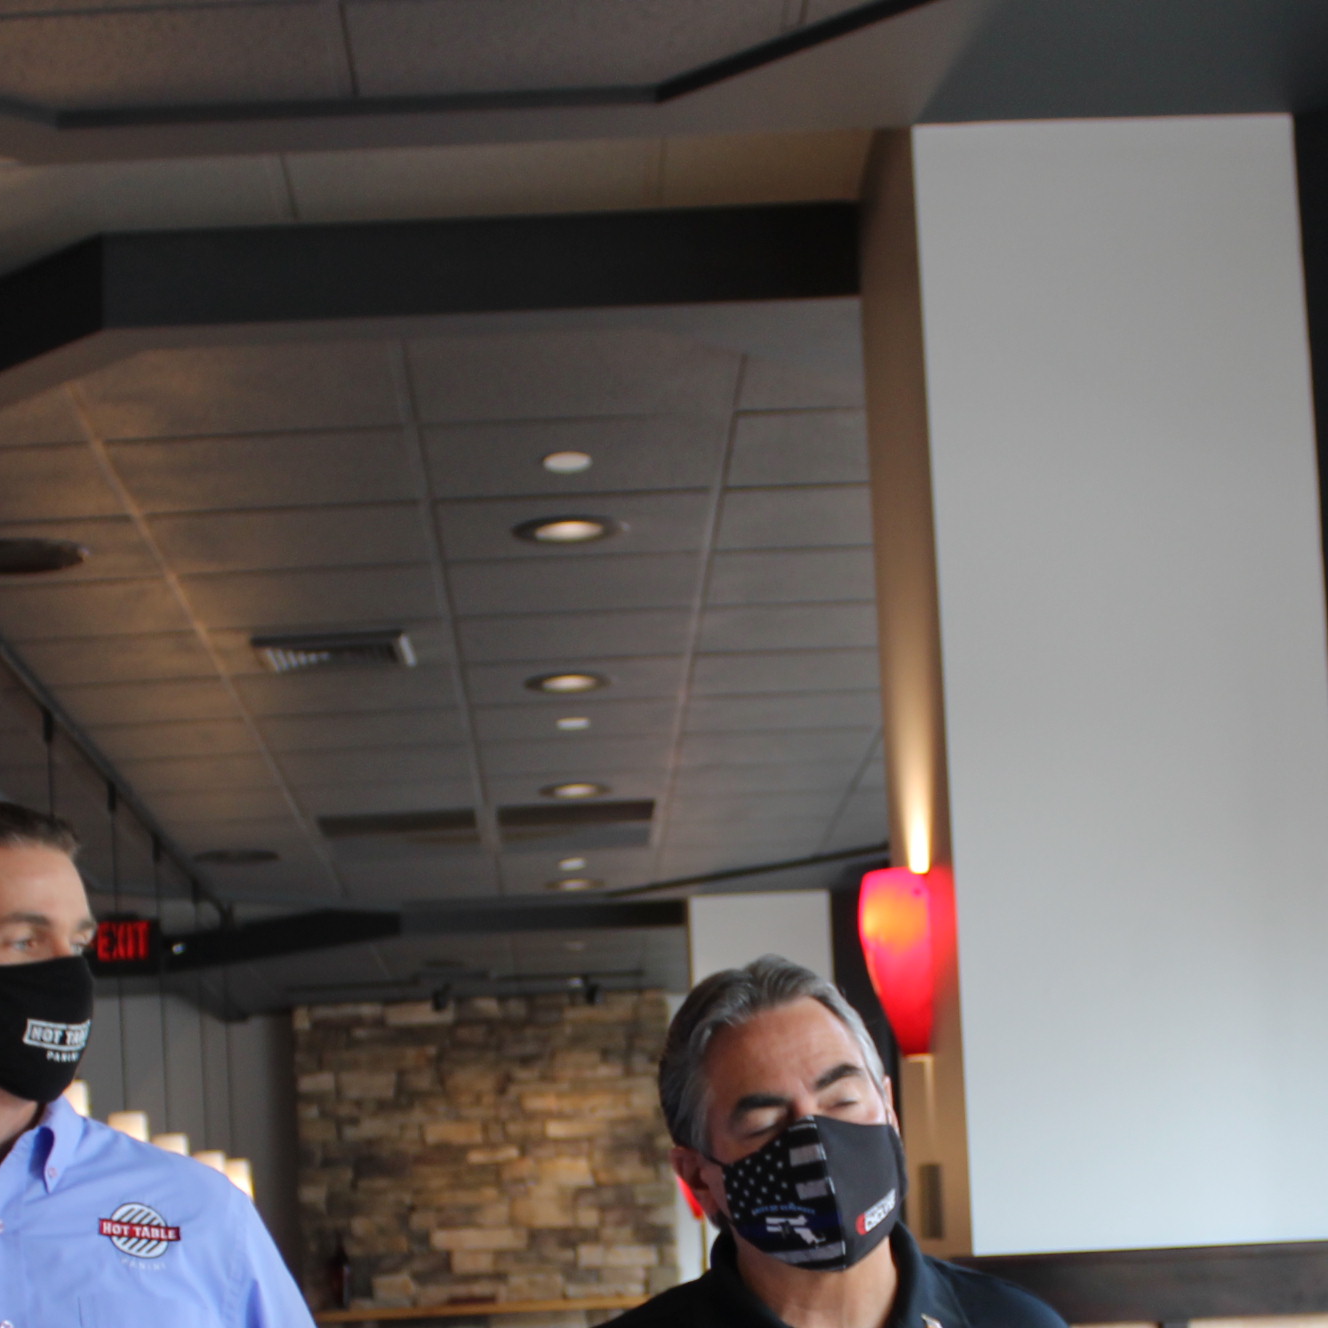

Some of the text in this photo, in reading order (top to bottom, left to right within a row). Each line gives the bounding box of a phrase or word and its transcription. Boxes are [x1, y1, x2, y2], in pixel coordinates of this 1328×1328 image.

[97, 921, 149, 961] EXIT
[31, 1026, 63, 1044] HOT
[102, 1221, 176, 1239] HOT TABLE
